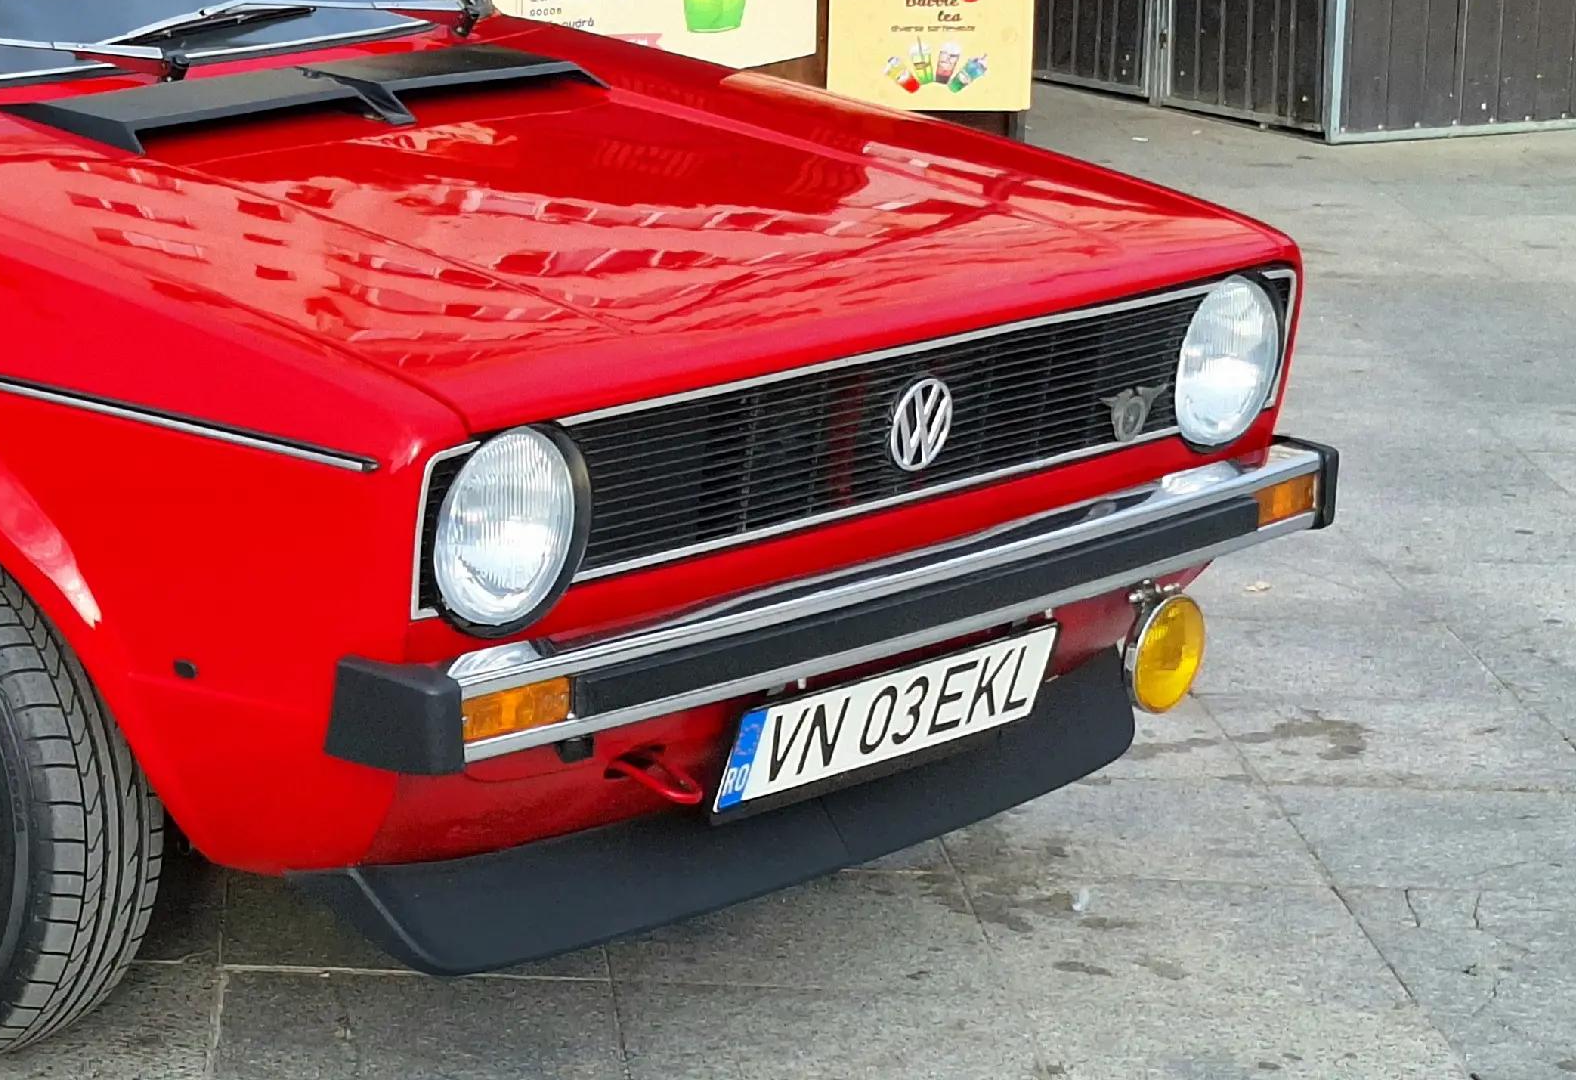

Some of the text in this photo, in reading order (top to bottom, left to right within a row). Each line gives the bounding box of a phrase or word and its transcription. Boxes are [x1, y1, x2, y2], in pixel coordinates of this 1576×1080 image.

[530, 7, 562, 17] cocos
[937, 10, 963, 22] tea
[767, 697, 850, 782] VN
[722, 764, 750, 793] RO
